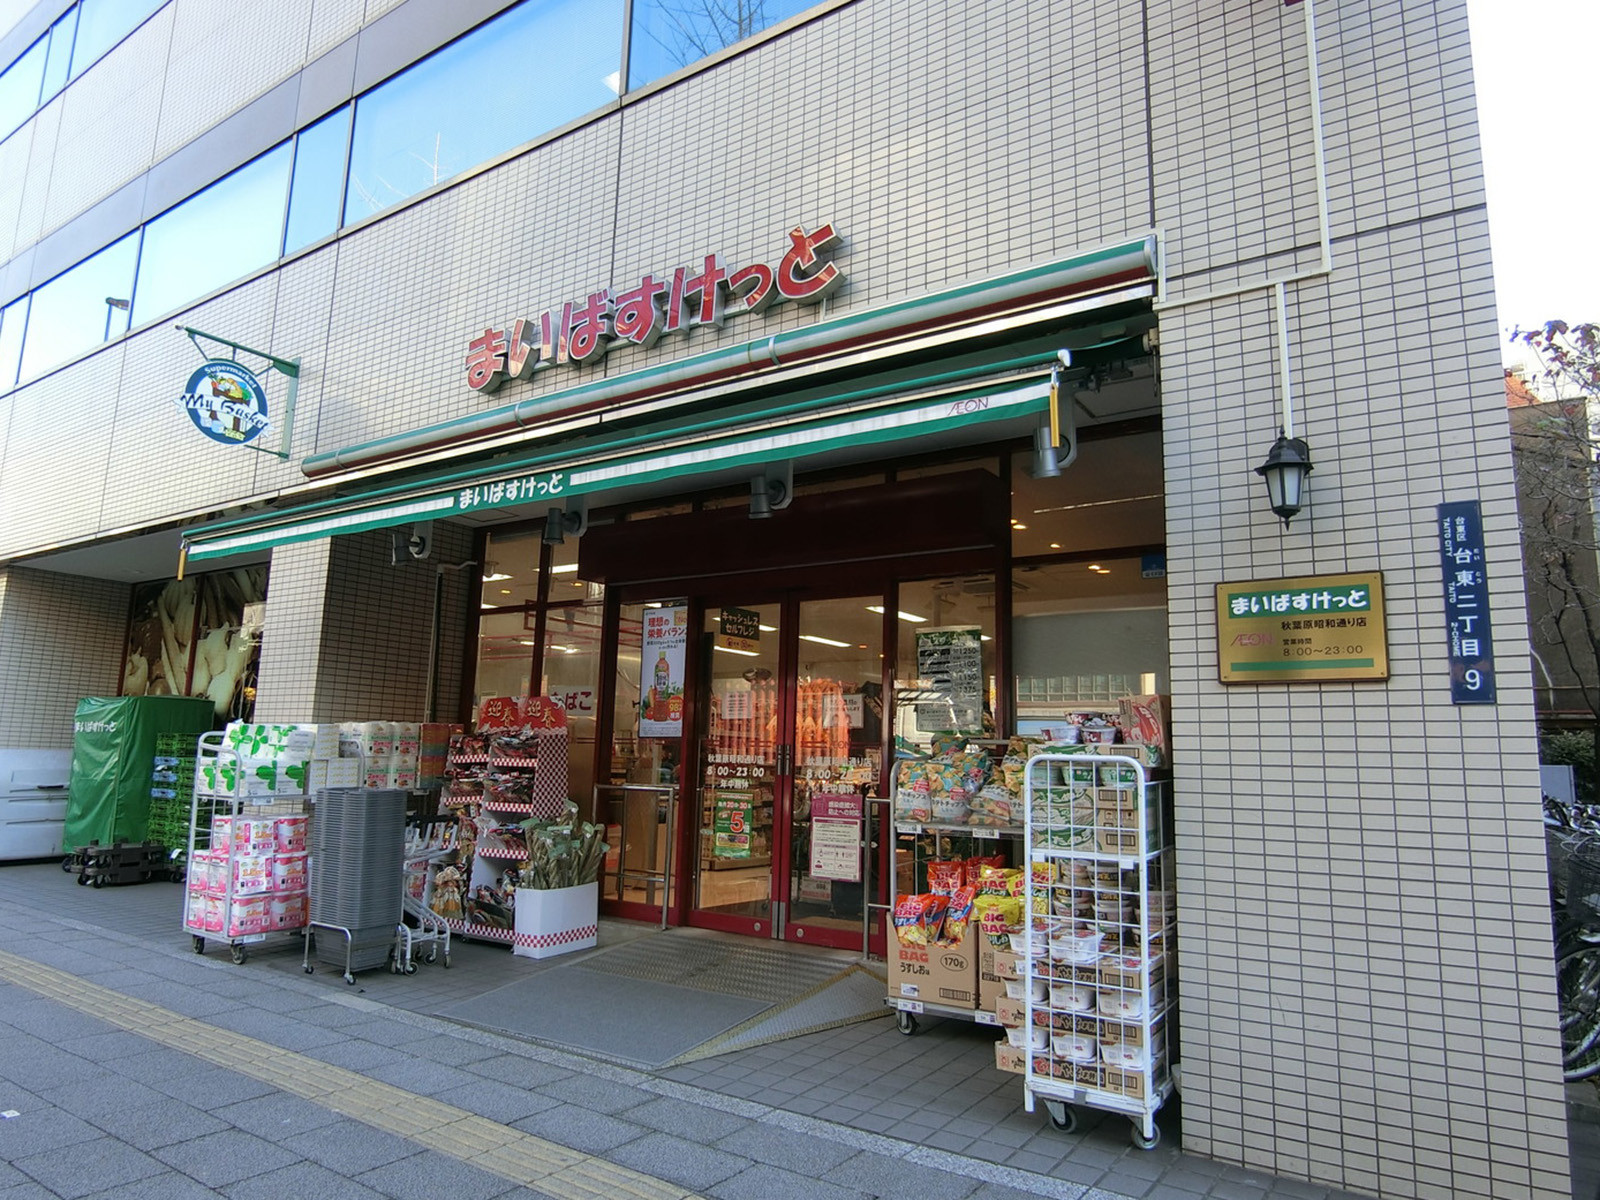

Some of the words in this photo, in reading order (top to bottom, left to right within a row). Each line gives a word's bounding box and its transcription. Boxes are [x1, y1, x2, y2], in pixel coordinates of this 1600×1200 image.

[465, 222, 846, 393] まいばすけっと
[204, 365, 258, 389] Supermarket
[180, 394, 213, 412] My
[220, 400, 269, 430] Basket
[459, 473, 564, 510] まいばすけっと
[1443, 516, 1452, 538] TAITO
[1454, 516, 1468, 542] 台東区
[1445, 539, 1453, 557] CITY
[1230, 589, 1368, 615] まいばすけっと
[1448, 581, 1457, 604] TAITO
[722, 611, 759, 626] キャッシュレス
[1281, 617, 1367, 631] 秋葉原昭和通り店
[1282, 638, 1313, 646] 営業時間
[1450, 621, 1461, 657] 2-CHOME
[1465, 669, 1482, 691] 9
[900, 902, 922, 911] BIG
[984, 912, 1005, 923] BIG
[981, 923, 1008, 935] BAG
[898, 949, 929, 963] BAG
